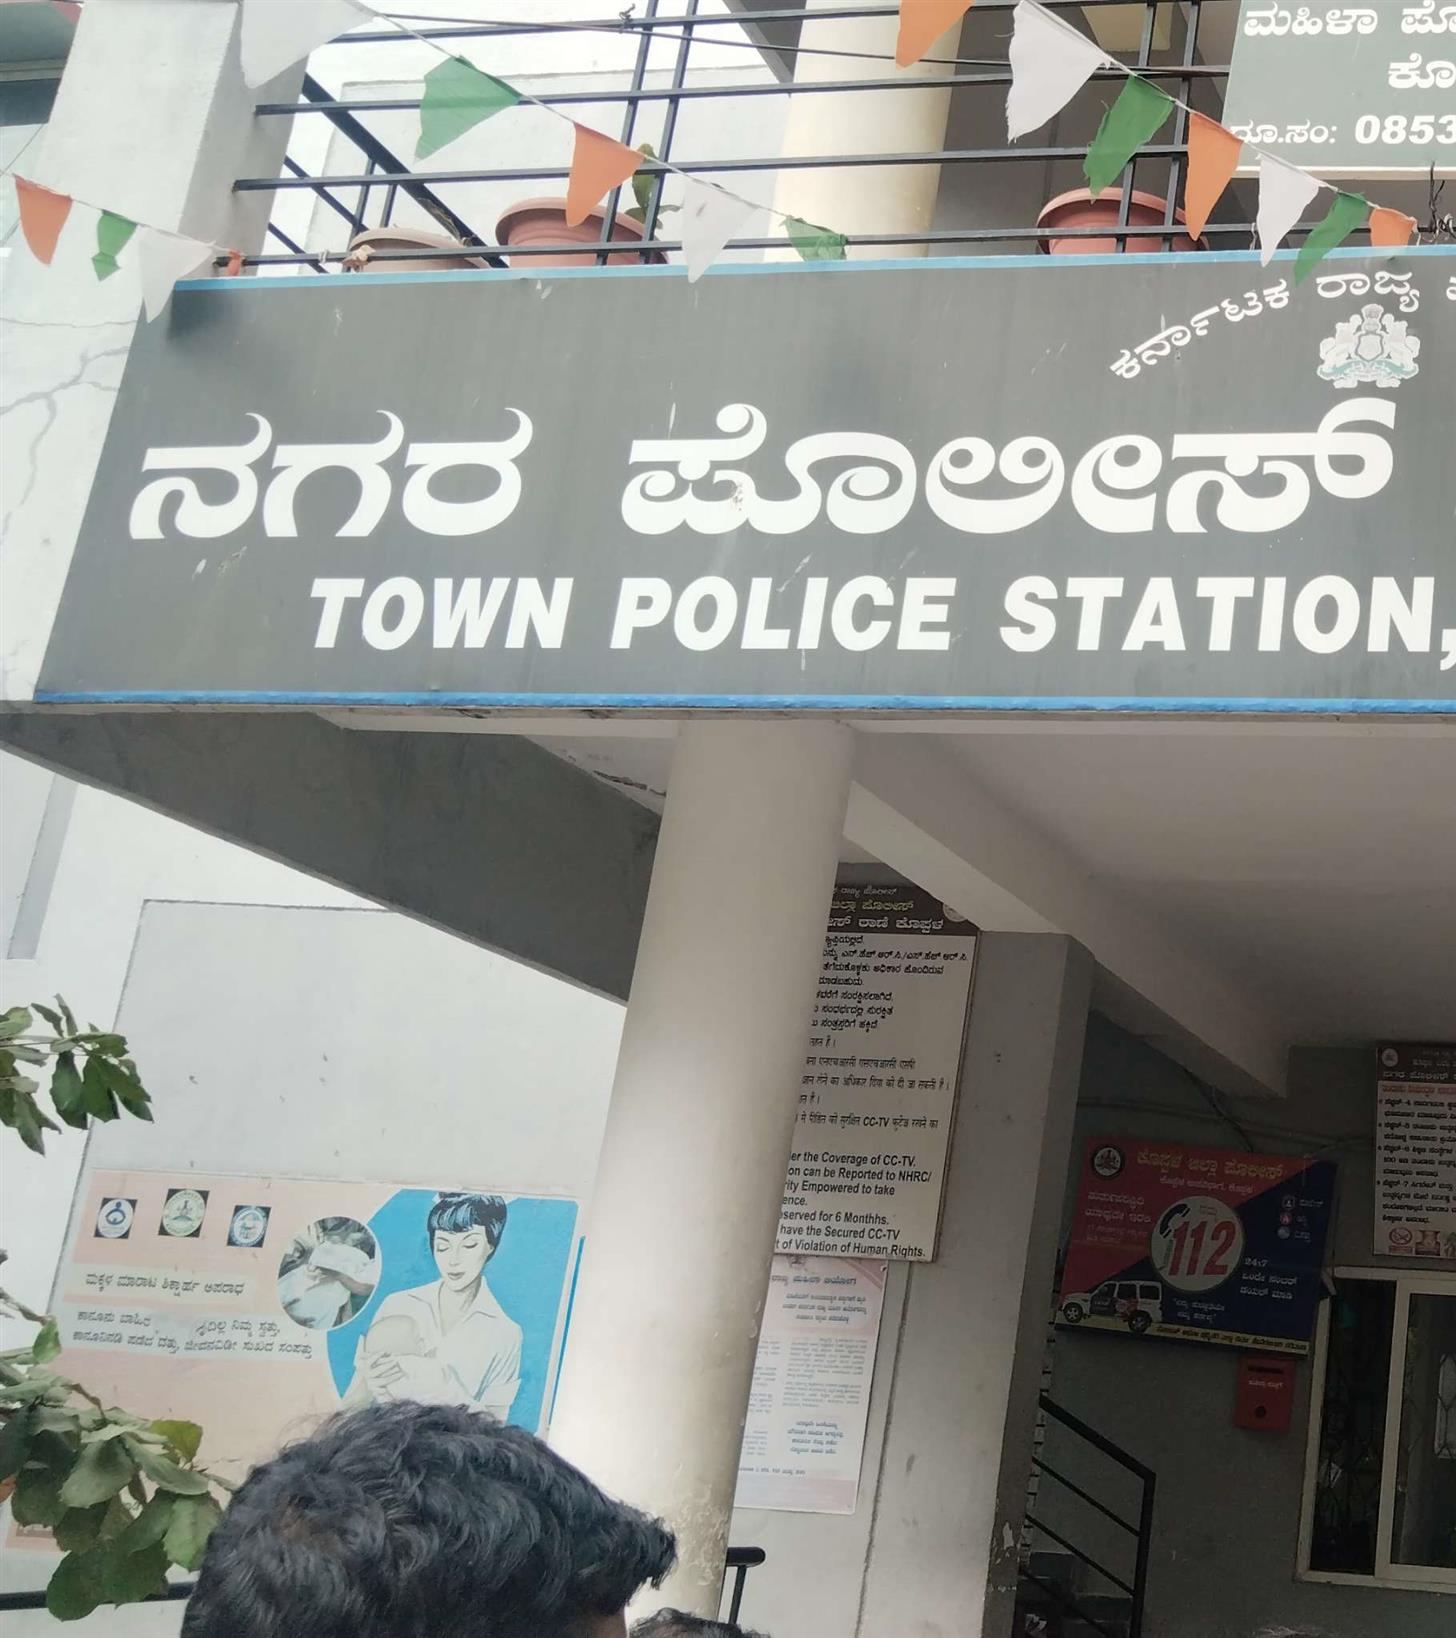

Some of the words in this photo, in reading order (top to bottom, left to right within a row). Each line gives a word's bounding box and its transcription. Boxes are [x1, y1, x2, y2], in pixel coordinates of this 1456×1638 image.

[1243, 3, 1378, 36] ಮಹಿಳಾ
[1108, 278, 1291, 380] ಕರ್ನಾಟಕ
[1315, 266, 1420, 313] ರಾಜ್ಯ
[128, 406, 534, 540] ನಗರ
[621, 397, 1397, 536] ಪೊಲೀಸ್
[311, 577, 574, 651] TOWN
[609, 576, 957, 651] POLICE
[863, 1116, 890, 1127] CC-TV
[803, 1152, 819, 1162] the
[822, 1152, 868, 1166] Coverage
[870, 1154, 881, 1165] of
[803, 1168, 820, 1177] can
[823, 1167, 836, 1177] be
[839, 1167, 883, 1182] Reported
[886, 1170, 895, 1180] to
[802, 1180, 859, 1194] Empowered
[862, 1183, 872, 1194] to
[874, 1184, 895, 1195] take
[782, 1210, 816, 1221] served
[819, 1211, 833, 1222] for
[835, 1213, 841, 1222] 6
[780, 1225, 803, 1235] have
[806, 1226, 822, 1236] the
[824, 1226, 865, 1239] Secured
[868, 1228, 900, 1240] CC-TV
[782, 1239, 793, 1249] of
[795, 1239, 837, 1252] Violation
[840, 1241, 852, 1253] of
[853, 1243, 887, 1255] Human
[1167, 1220, 1237, 1277] 112
